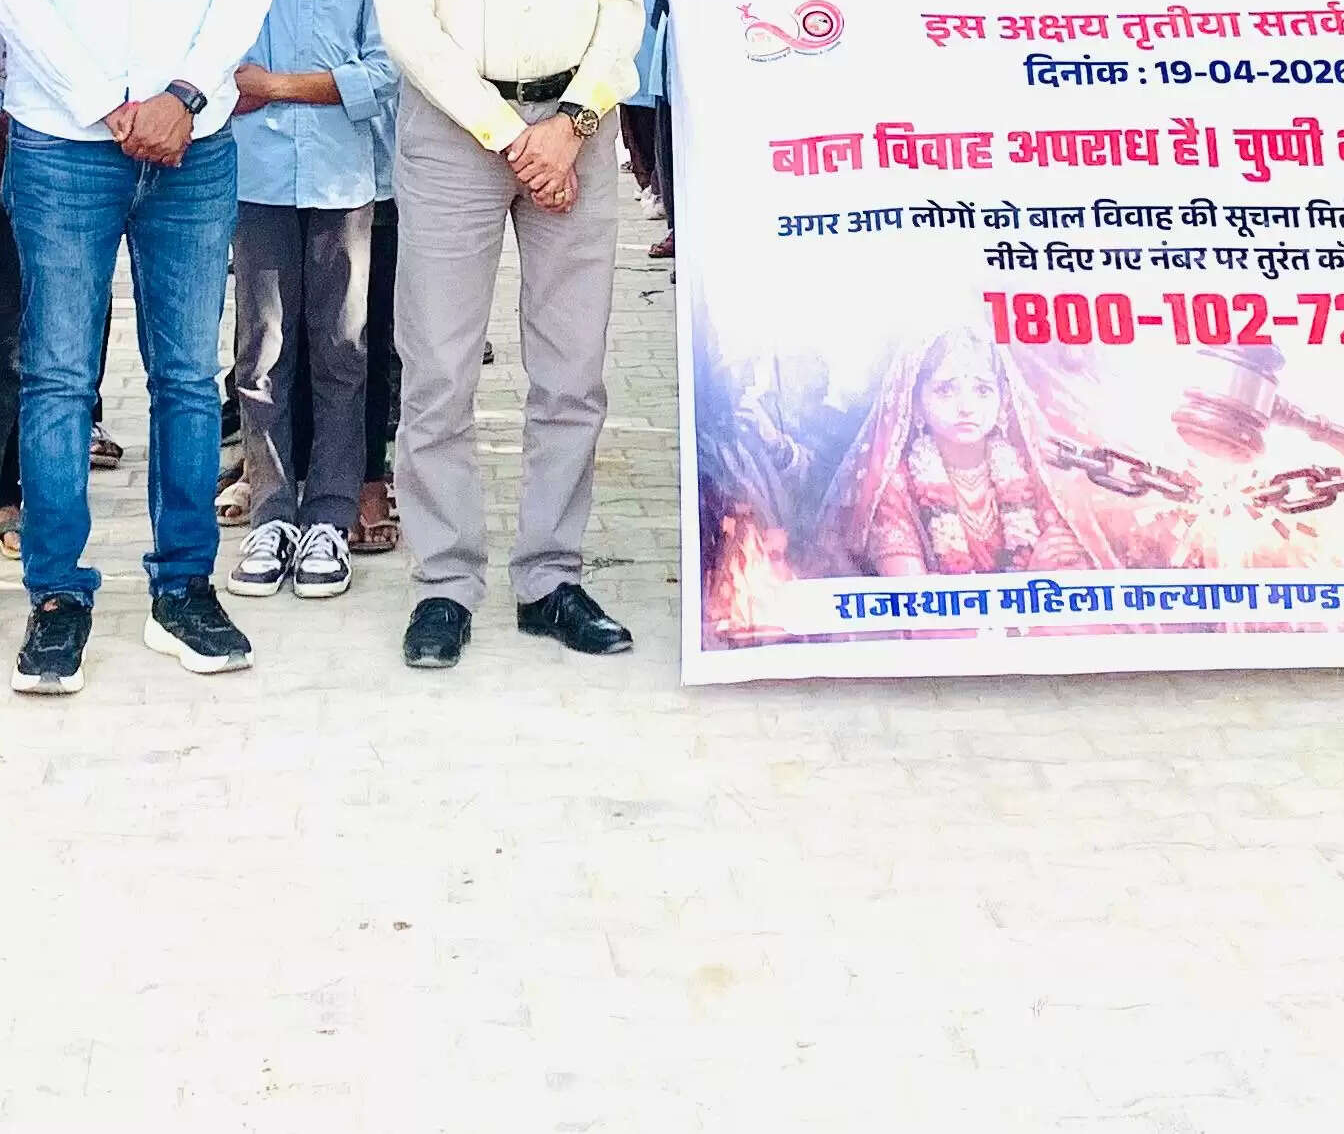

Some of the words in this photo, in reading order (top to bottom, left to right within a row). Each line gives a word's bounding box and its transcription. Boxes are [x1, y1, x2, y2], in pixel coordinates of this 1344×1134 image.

[920, 12, 986, 47] इस
[998, 14, 1109, 43] अक्षय
[1117, 4, 1241, 52] तृतीया
[1024, 53, 1129, 88] दिनांक
[768, 131, 864, 178] बाल
[872, 121, 994, 172] विवाह
[1008, 126, 1160, 168] अपराध
[1167, 116, 1219, 169] है।
[1233, 116, 1324, 183] चुप्पी
[777, 214, 839, 237] अगर
[847, 207, 903, 234] आप
[911, 197, 976, 231] लोगों
[981, 200, 1021, 231] को
[1028, 204, 1085, 231] बाल
[1090, 198, 1173, 231] विवाह
[1178, 198, 1217, 230] की
[1224, 204, 1300, 239] सूचना
[984, 241, 1038, 272] नीचे
[1044, 240, 1093, 272] दिए
[1102, 248, 1143, 271] गए
[1149, 240, 1206, 270] नंबर
[1215, 248, 1248, 270] पर
[1256, 241, 1310, 280] तुरंत
[833, 586, 989, 623] राजस्थान
[996, 578, 1116, 618] महिला
[1123, 582, 1257, 618] कल्याण
